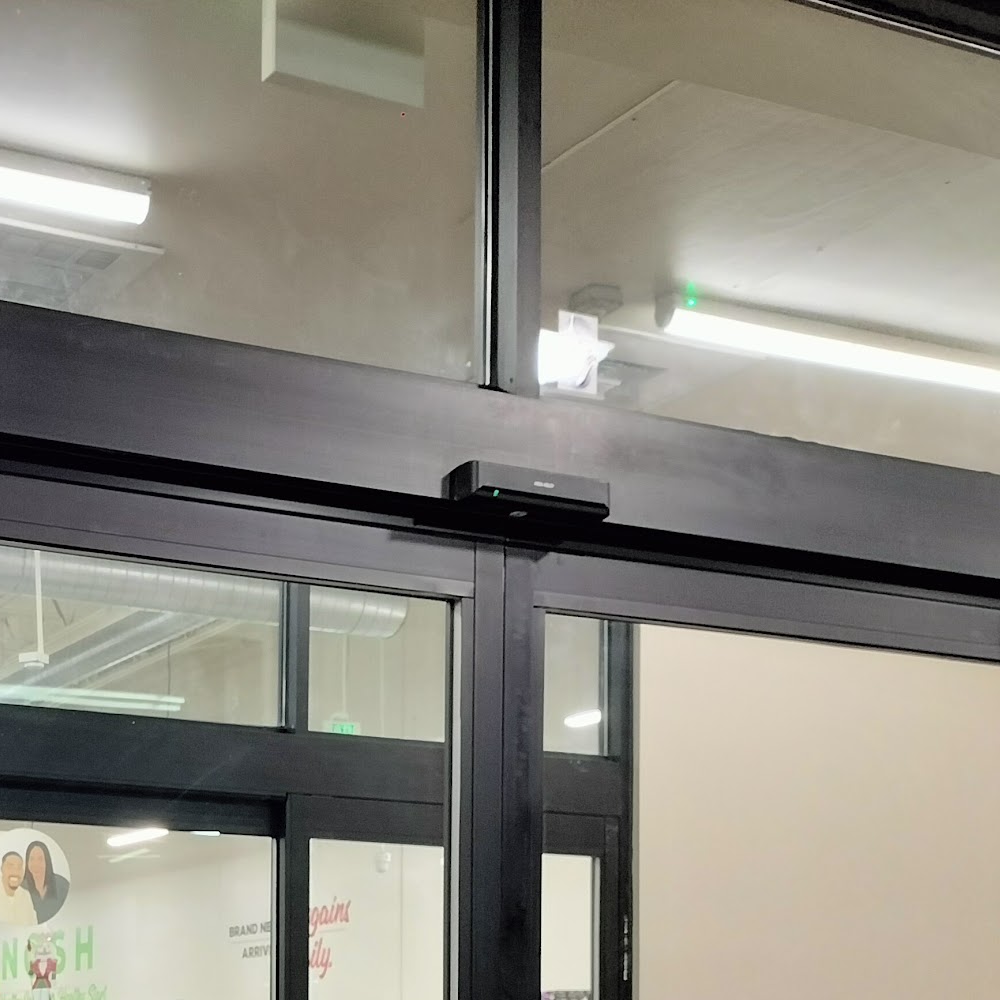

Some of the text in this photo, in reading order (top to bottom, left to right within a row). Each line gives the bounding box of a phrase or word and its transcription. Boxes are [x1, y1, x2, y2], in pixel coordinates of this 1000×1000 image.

[229, 921, 271, 937] BRAND NE
[242, 945, 270, 959] ARRIV
